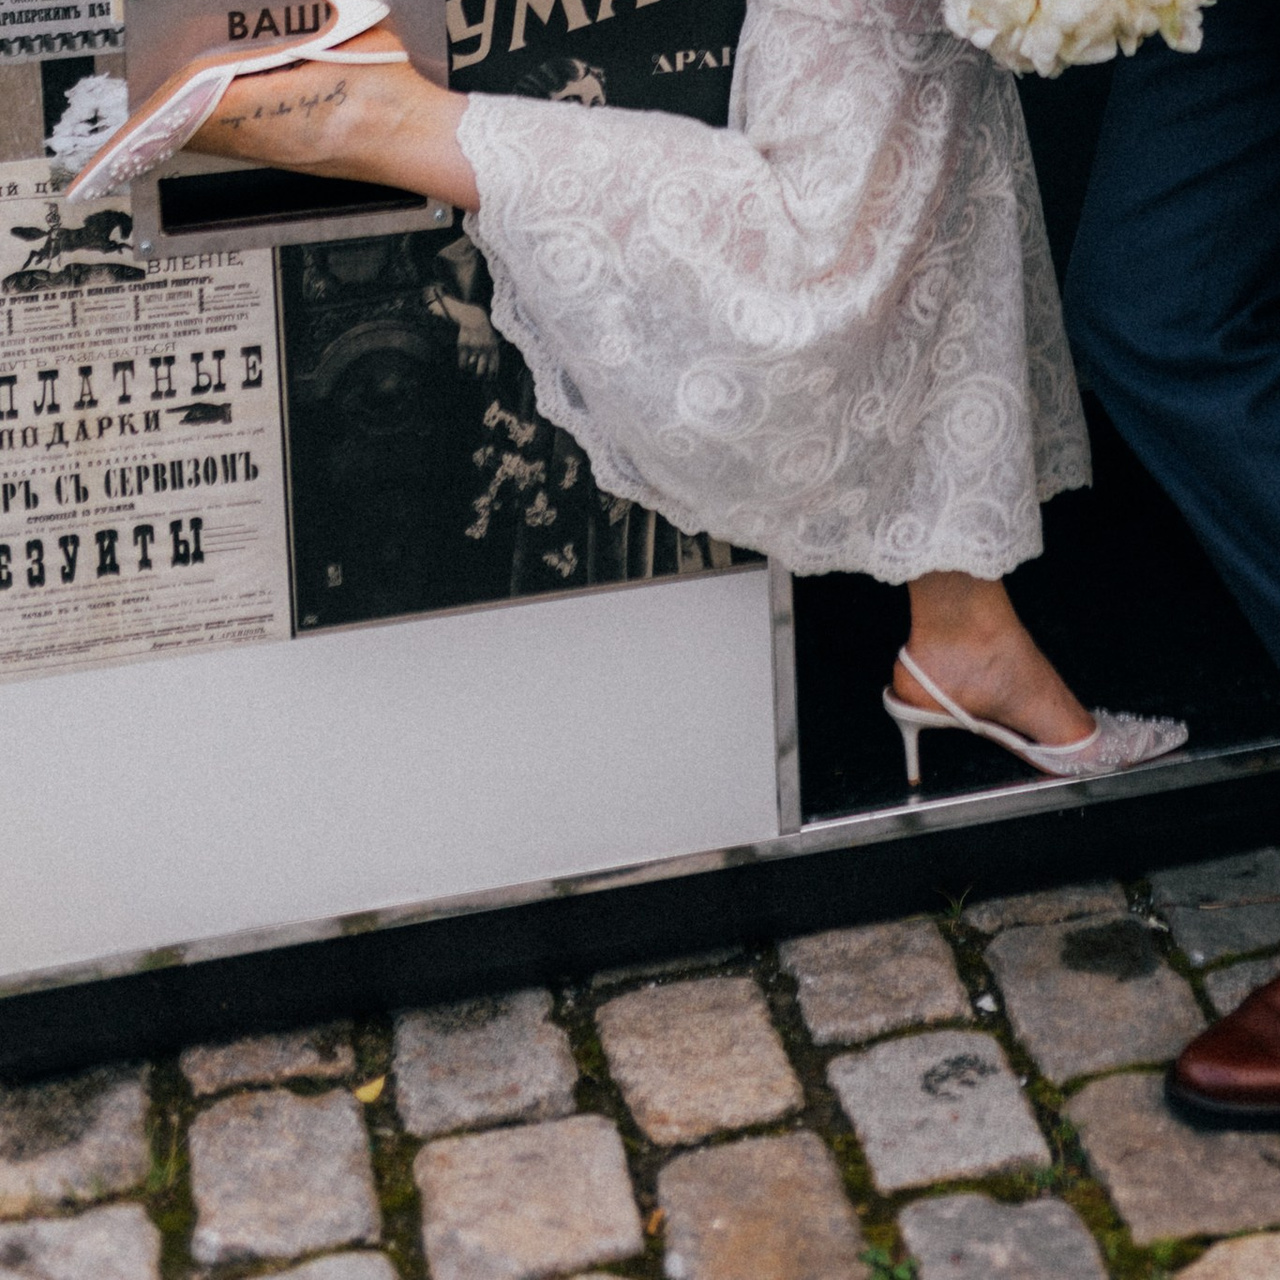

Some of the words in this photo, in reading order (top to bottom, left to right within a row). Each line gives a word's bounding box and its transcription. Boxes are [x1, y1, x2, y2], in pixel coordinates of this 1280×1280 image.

[0, 408, 161, 451] ПОДАРКИ
[54, 473, 90, 506] СЪ
[103, 450, 260, 501] СЕРВИЗОМЪ
